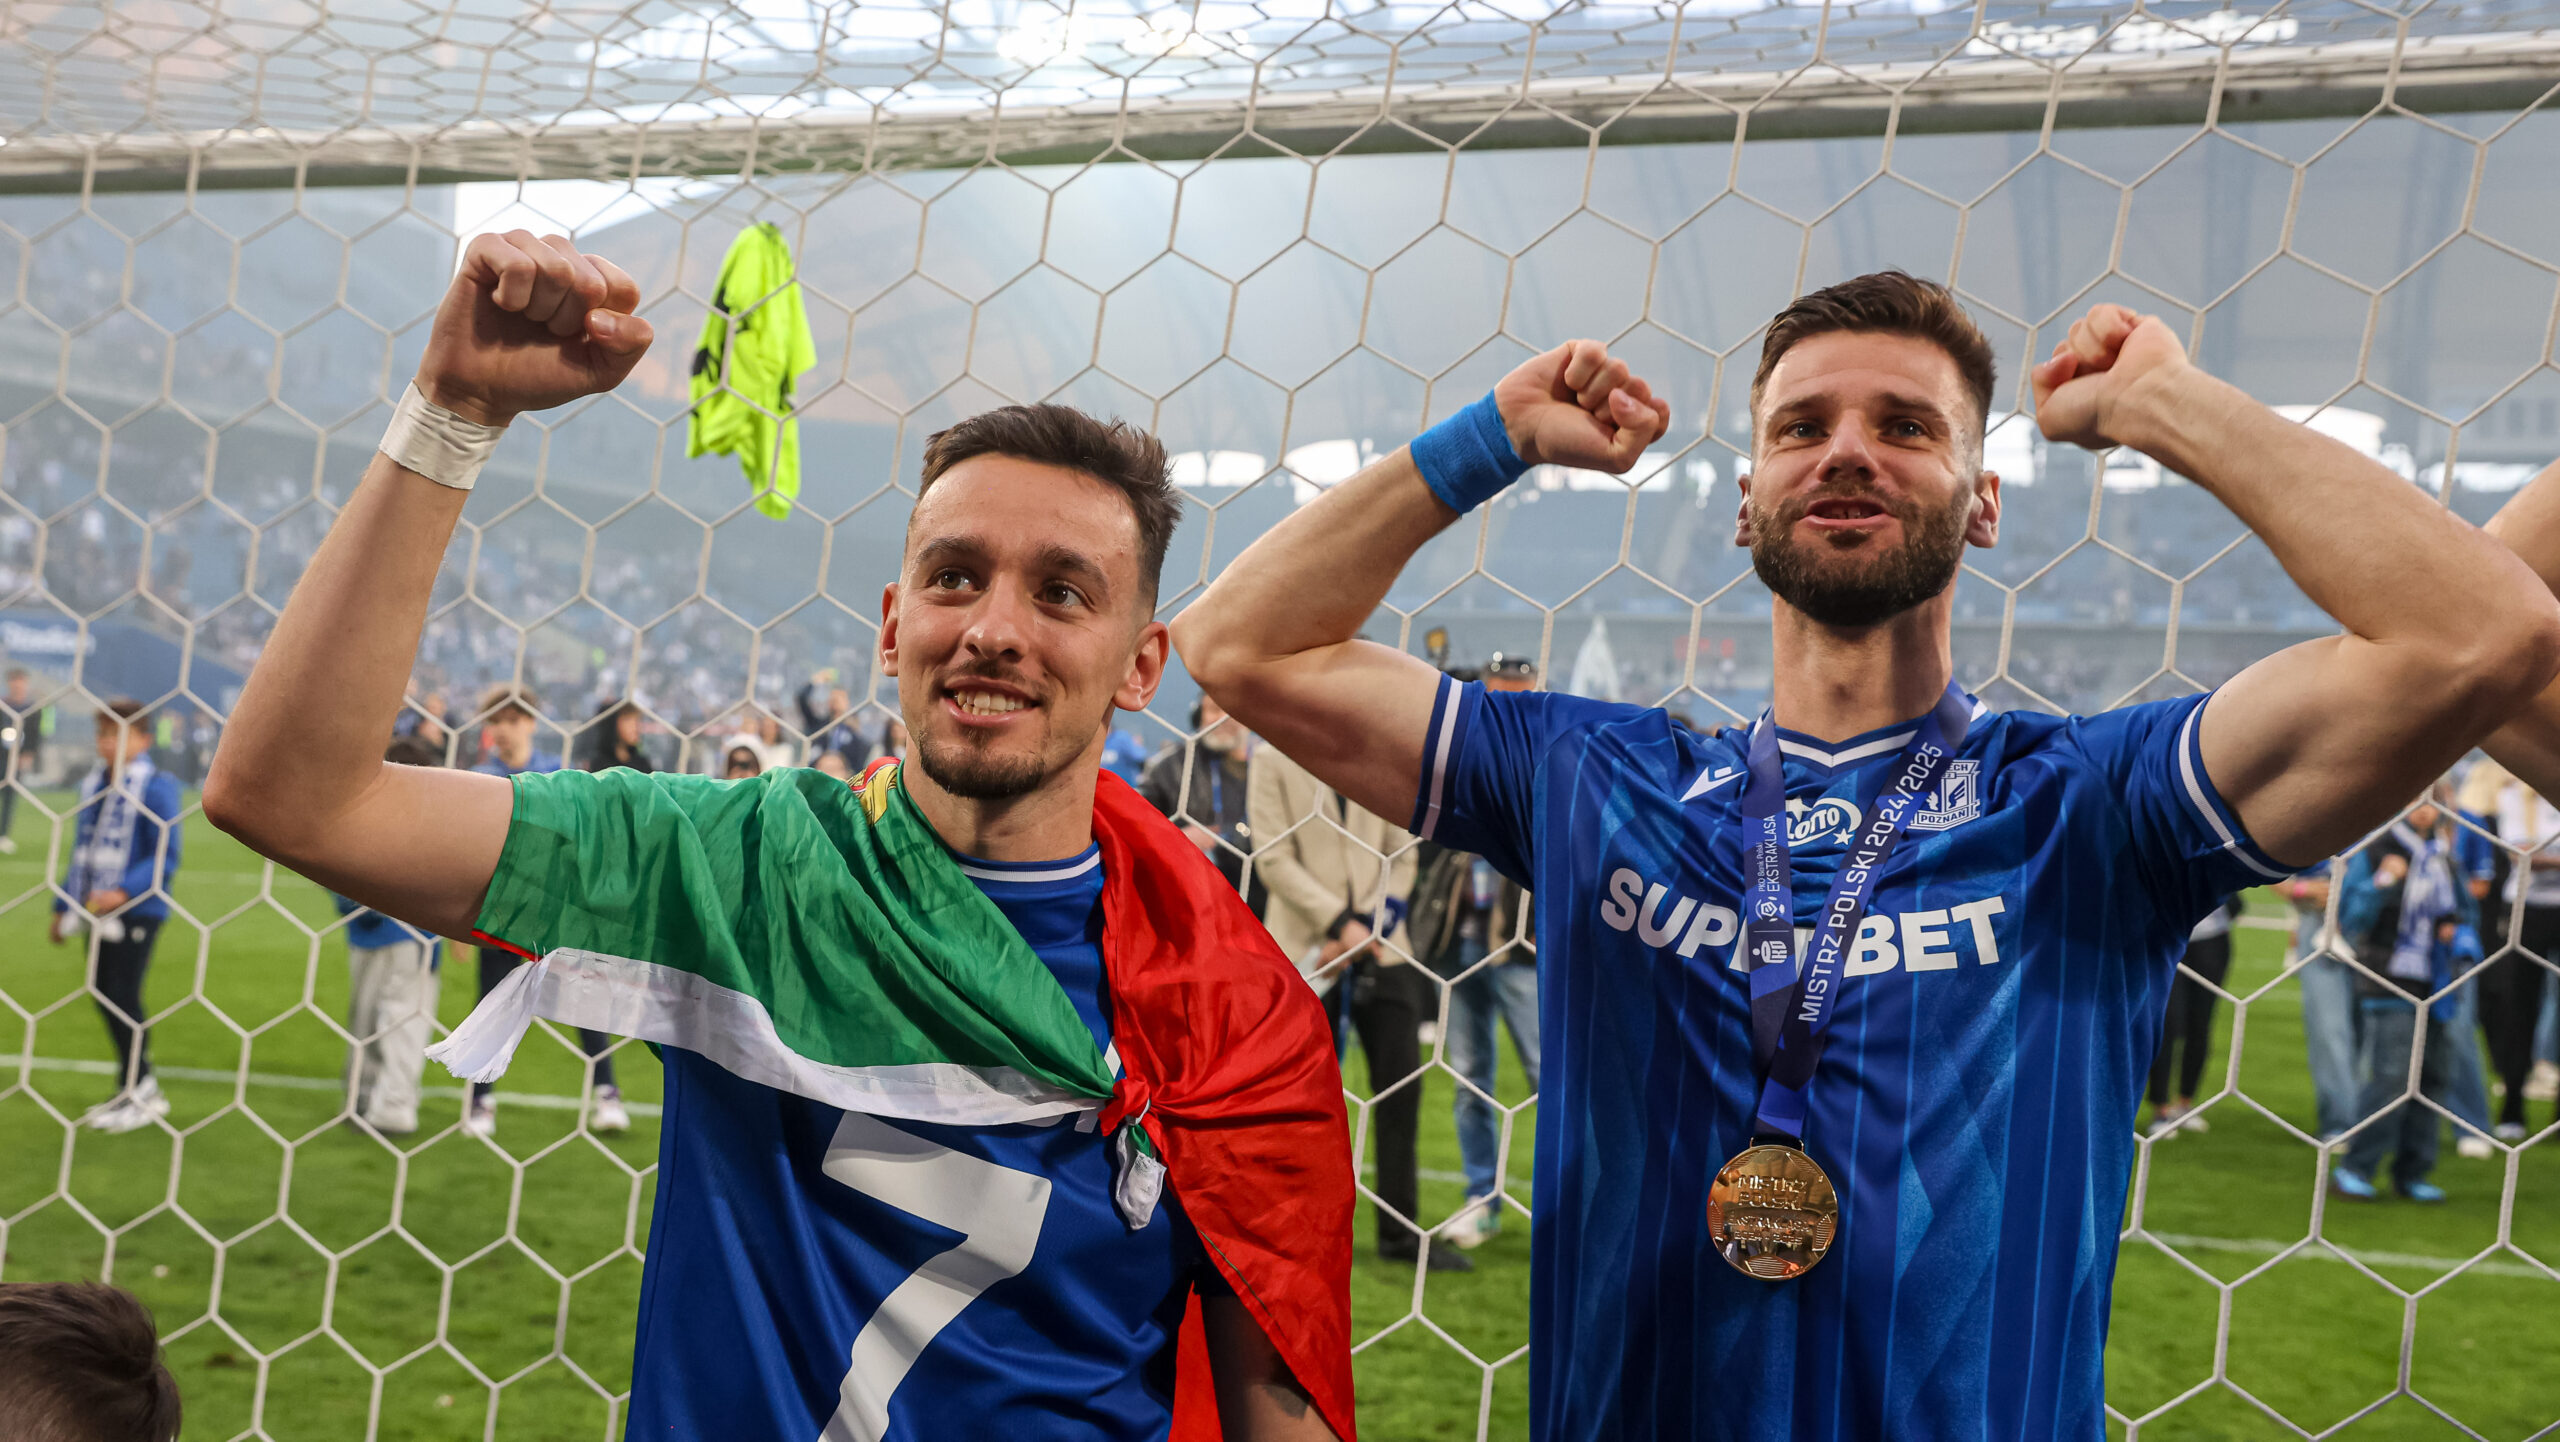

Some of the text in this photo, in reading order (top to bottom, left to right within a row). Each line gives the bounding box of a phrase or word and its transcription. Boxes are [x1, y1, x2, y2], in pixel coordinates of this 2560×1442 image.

[1763, 815, 1780, 892] EKSTRAKLASA
[1786, 807, 1841, 840] LOTTO
[1757, 861, 1766, 877] Bank
[1758, 877, 1766, 892] PKO
[1798, 742, 1943, 1023] MISTRZ POLSKI 2024/2025
[1600, 867, 2006, 980] SUPBET
[819, 1110, 1052, 1442] 7
